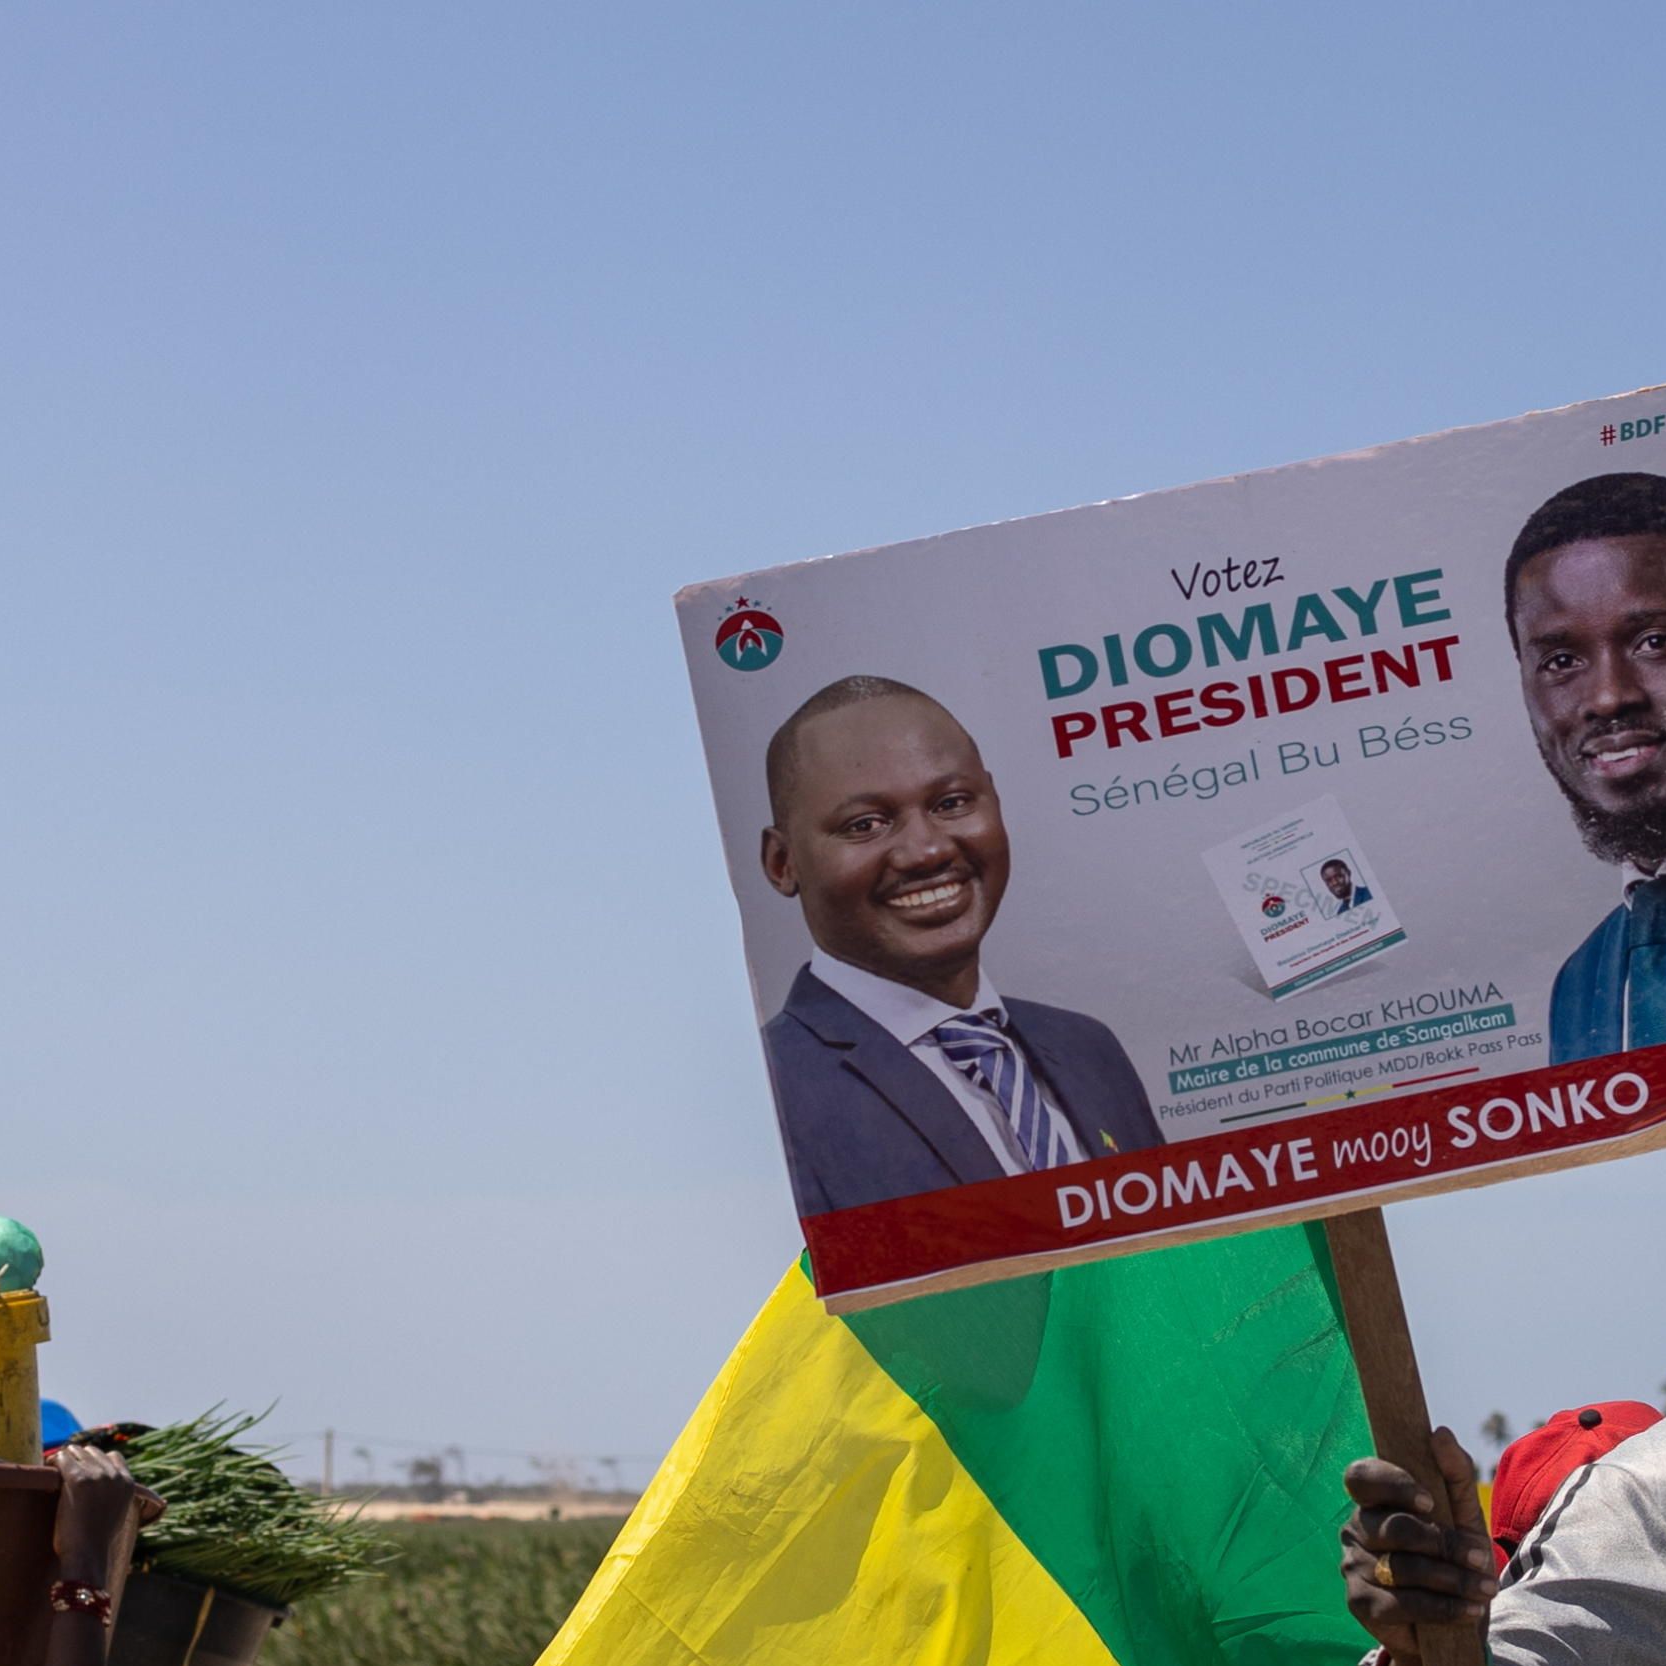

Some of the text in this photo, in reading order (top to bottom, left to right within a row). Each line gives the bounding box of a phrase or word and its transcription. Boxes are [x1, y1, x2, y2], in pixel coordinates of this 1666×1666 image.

[1171, 556, 1284, 601] Votez
[1037, 567, 1452, 700] DIOMAYE
[1050, 634, 1460, 759] PRESIDENT
[1069, 714, 1473, 817] Sénégal Bu Béss
[1259, 910, 1307, 936] DIOMAYE
[1263, 917, 1310, 943] PRESIDENT
[1168, 981, 1504, 1067] Mr Alpha Bocar KHOUMA
[1175, 1011, 1508, 1092] Maire de la commune de Sangalkam
[1158, 1032, 1543, 1121] Président du Parti Politique MDD/Bokk Pass Pass
[1055, 1071, 1650, 1229] DIOMAYE mooy SONKO
